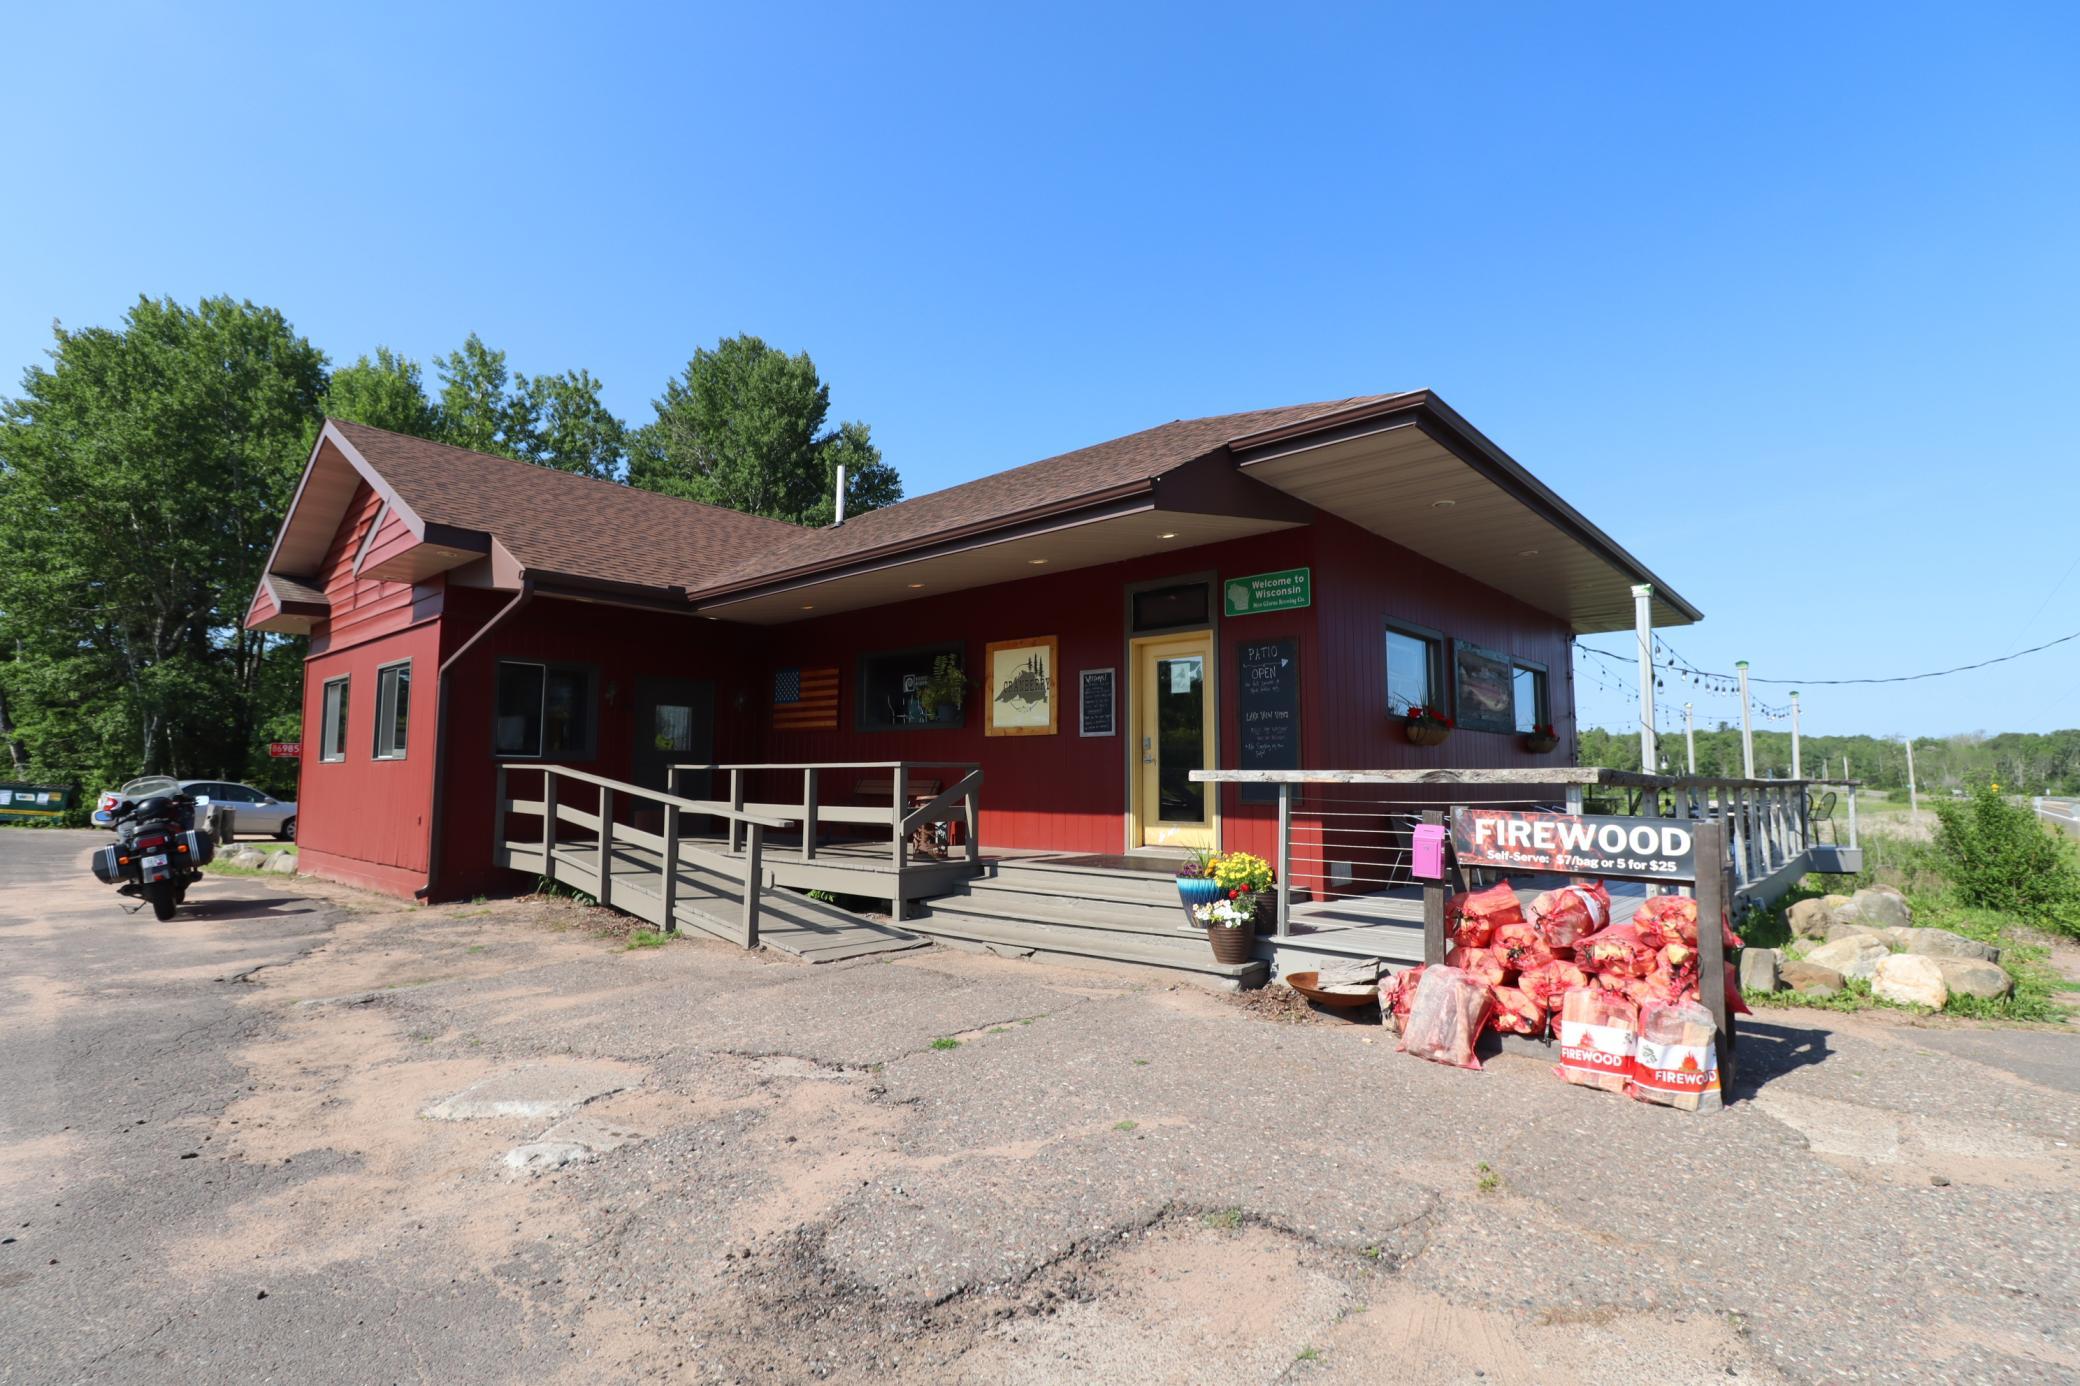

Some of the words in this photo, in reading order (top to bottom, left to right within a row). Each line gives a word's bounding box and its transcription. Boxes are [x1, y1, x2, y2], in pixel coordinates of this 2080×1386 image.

[1252, 578, 1292, 589] Welcome
[1294, 575, 1304, 583] to
[1255, 586, 1301, 599] Wisconsin
[1248, 645, 1278, 661] PATIO
[1251, 665, 1276, 680] OPEN
[1003, 677, 1051, 693] CRANBERRY
[1474, 818, 1692, 857] FIREWOOD
[1487, 849, 1550, 864] Self-Serve:
[1556, 854, 1599, 869] $7/bag
[1601, 859, 1615, 868] or
[1616, 858, 1626, 869] 5
[1628, 858, 1647, 871] for
[1649, 860, 1677, 872] $25
[1561, 1047, 1622, 1067] FIREWOOD
